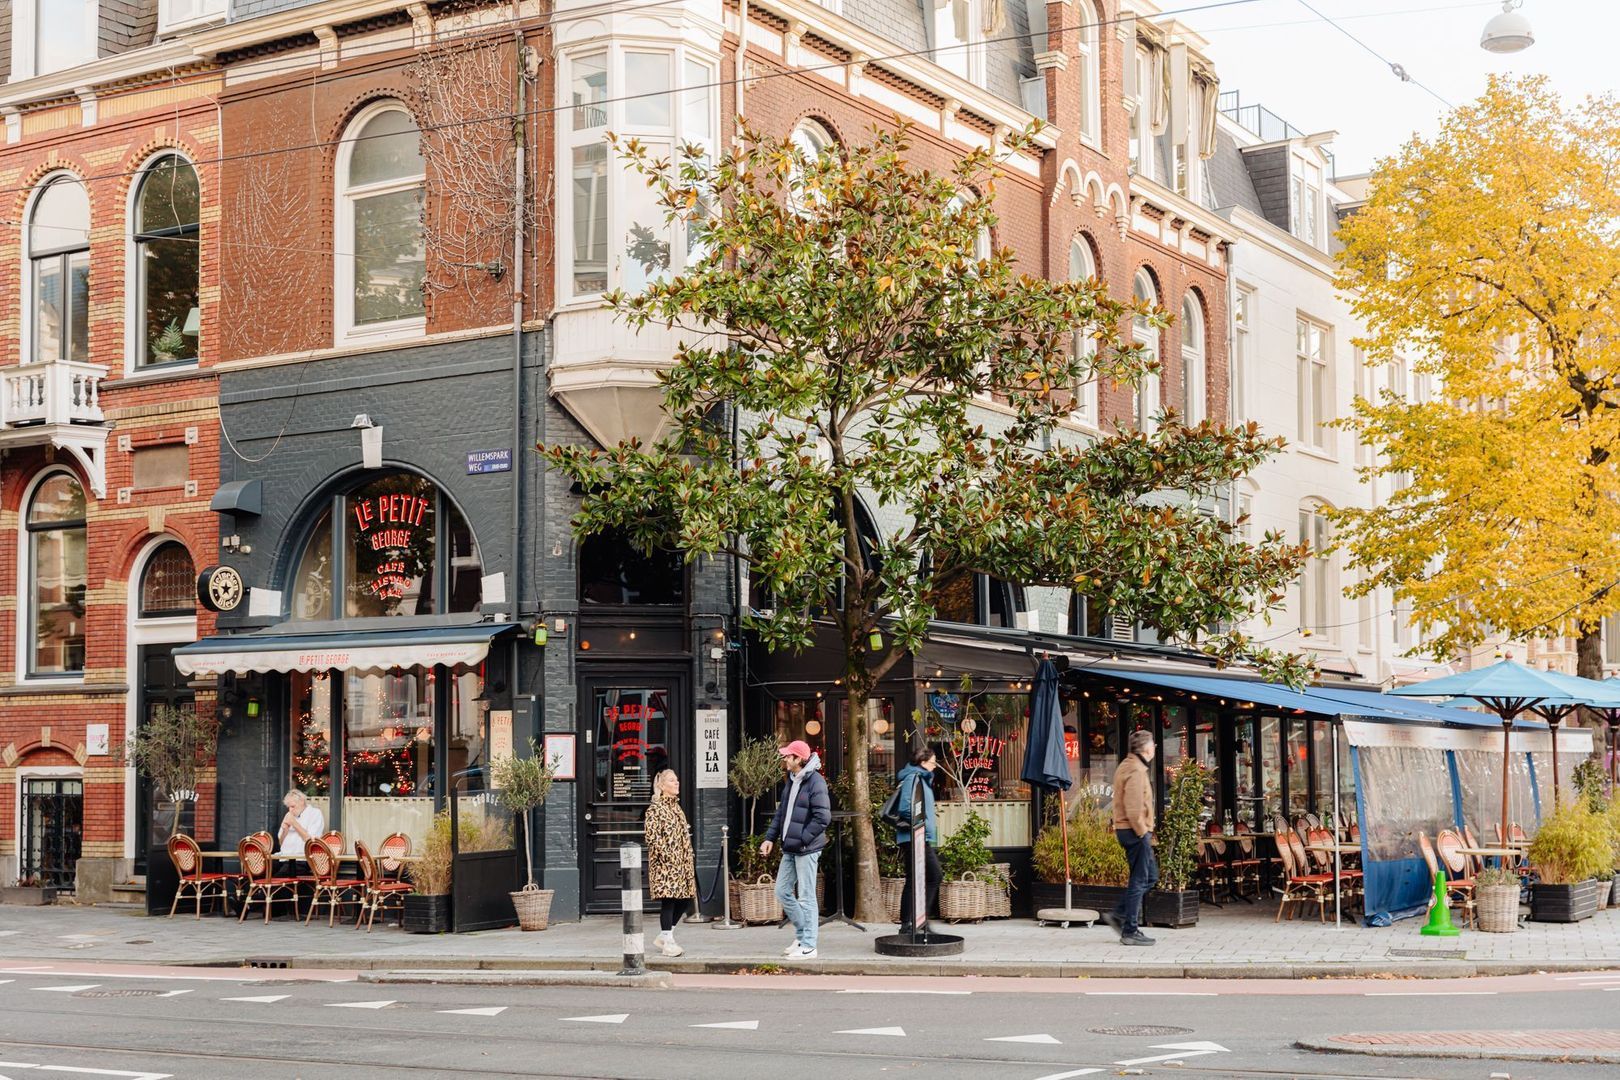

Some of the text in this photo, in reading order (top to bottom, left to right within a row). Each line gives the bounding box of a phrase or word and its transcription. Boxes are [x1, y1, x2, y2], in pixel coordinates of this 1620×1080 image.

[468, 451, 508, 462] WILLEMSPARK
[468, 463, 482, 472] WEG
[355, 494, 428, 531] LE PETIT
[371, 529, 411, 550] GEORGE
[212, 571, 239, 591] Heineken
[217, 597, 234, 608] Bier
[326, 653, 350, 665] GEORGE
[623, 704, 656, 721] PETIT
[704, 727, 720, 740] CAFÉ
[708, 740, 717, 750] AU
[705, 751, 720, 762] LA
[705, 762, 720, 773] LA
